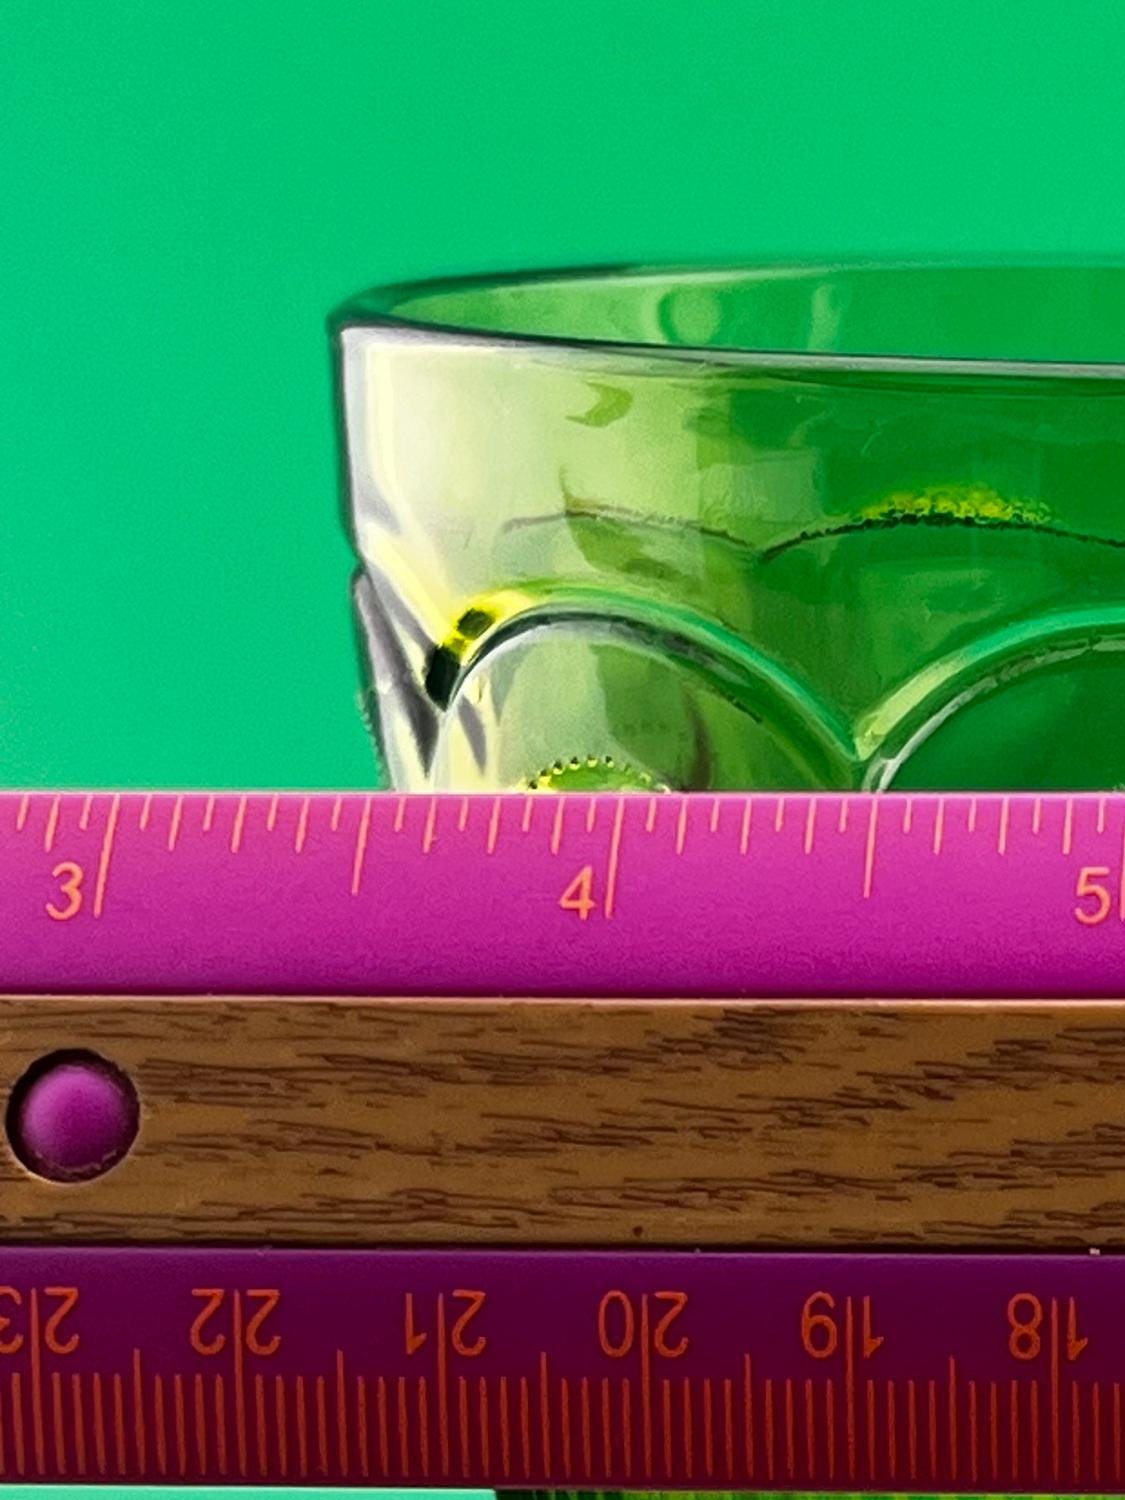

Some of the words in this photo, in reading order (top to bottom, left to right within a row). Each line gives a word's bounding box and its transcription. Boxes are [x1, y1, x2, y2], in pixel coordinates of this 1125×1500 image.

[46, 862, 82, 919] 3
[560, 867, 594, 919] 4
[1075, 867, 1110, 922] 5
